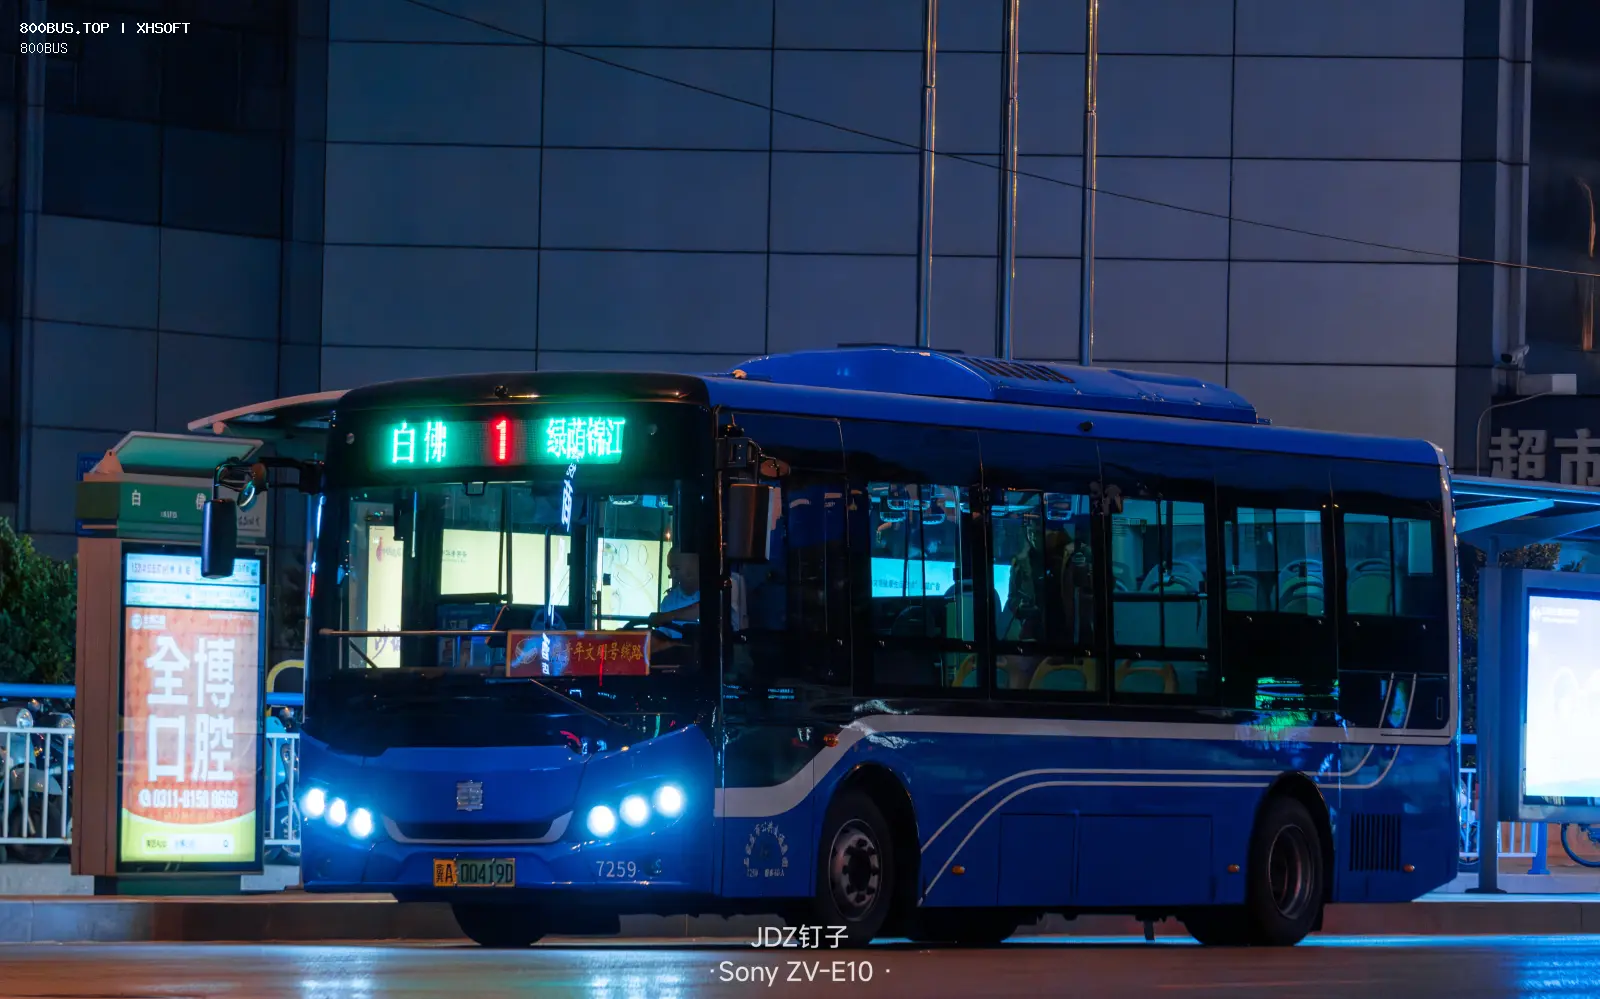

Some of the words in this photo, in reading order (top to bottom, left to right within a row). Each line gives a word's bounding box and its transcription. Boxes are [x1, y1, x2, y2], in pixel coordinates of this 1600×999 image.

[391, 421, 447, 463] 白佛
[496, 419, 507, 460] 1
[546, 416, 625, 460] 绿荫锦江
[1488, 428, 1600, 486] 超市
[145, 635, 236, 708] 全博
[147, 713, 235, 783] 口腔
[596, 861, 636, 877] 7259
